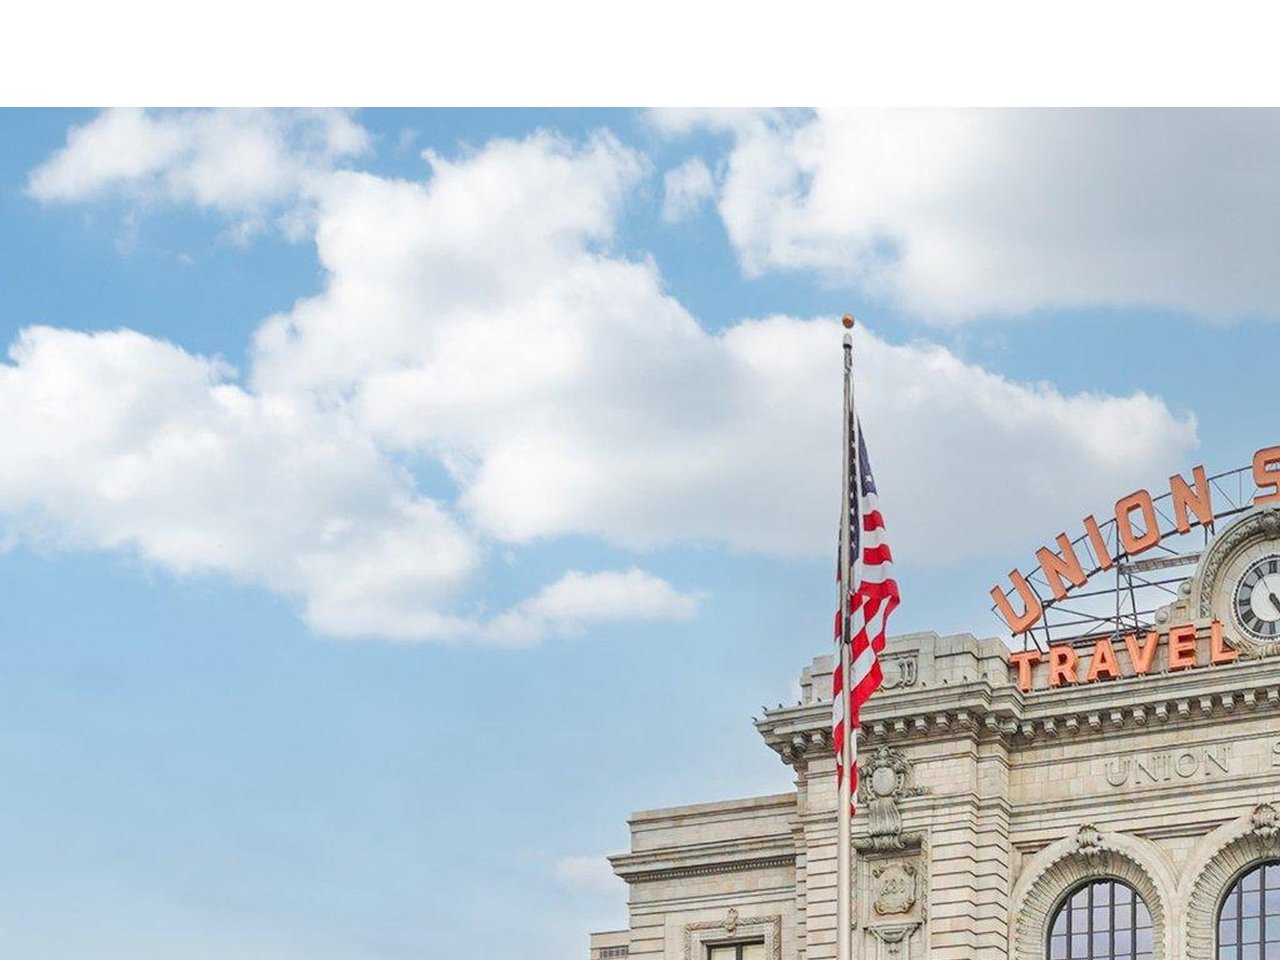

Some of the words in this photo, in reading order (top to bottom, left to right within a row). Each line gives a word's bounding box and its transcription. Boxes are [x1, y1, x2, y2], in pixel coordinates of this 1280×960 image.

[990, 465, 1213, 634] UNION
[1009, 616, 1240, 691] TRAVEL
[1105, 747, 1231, 787] UNION
